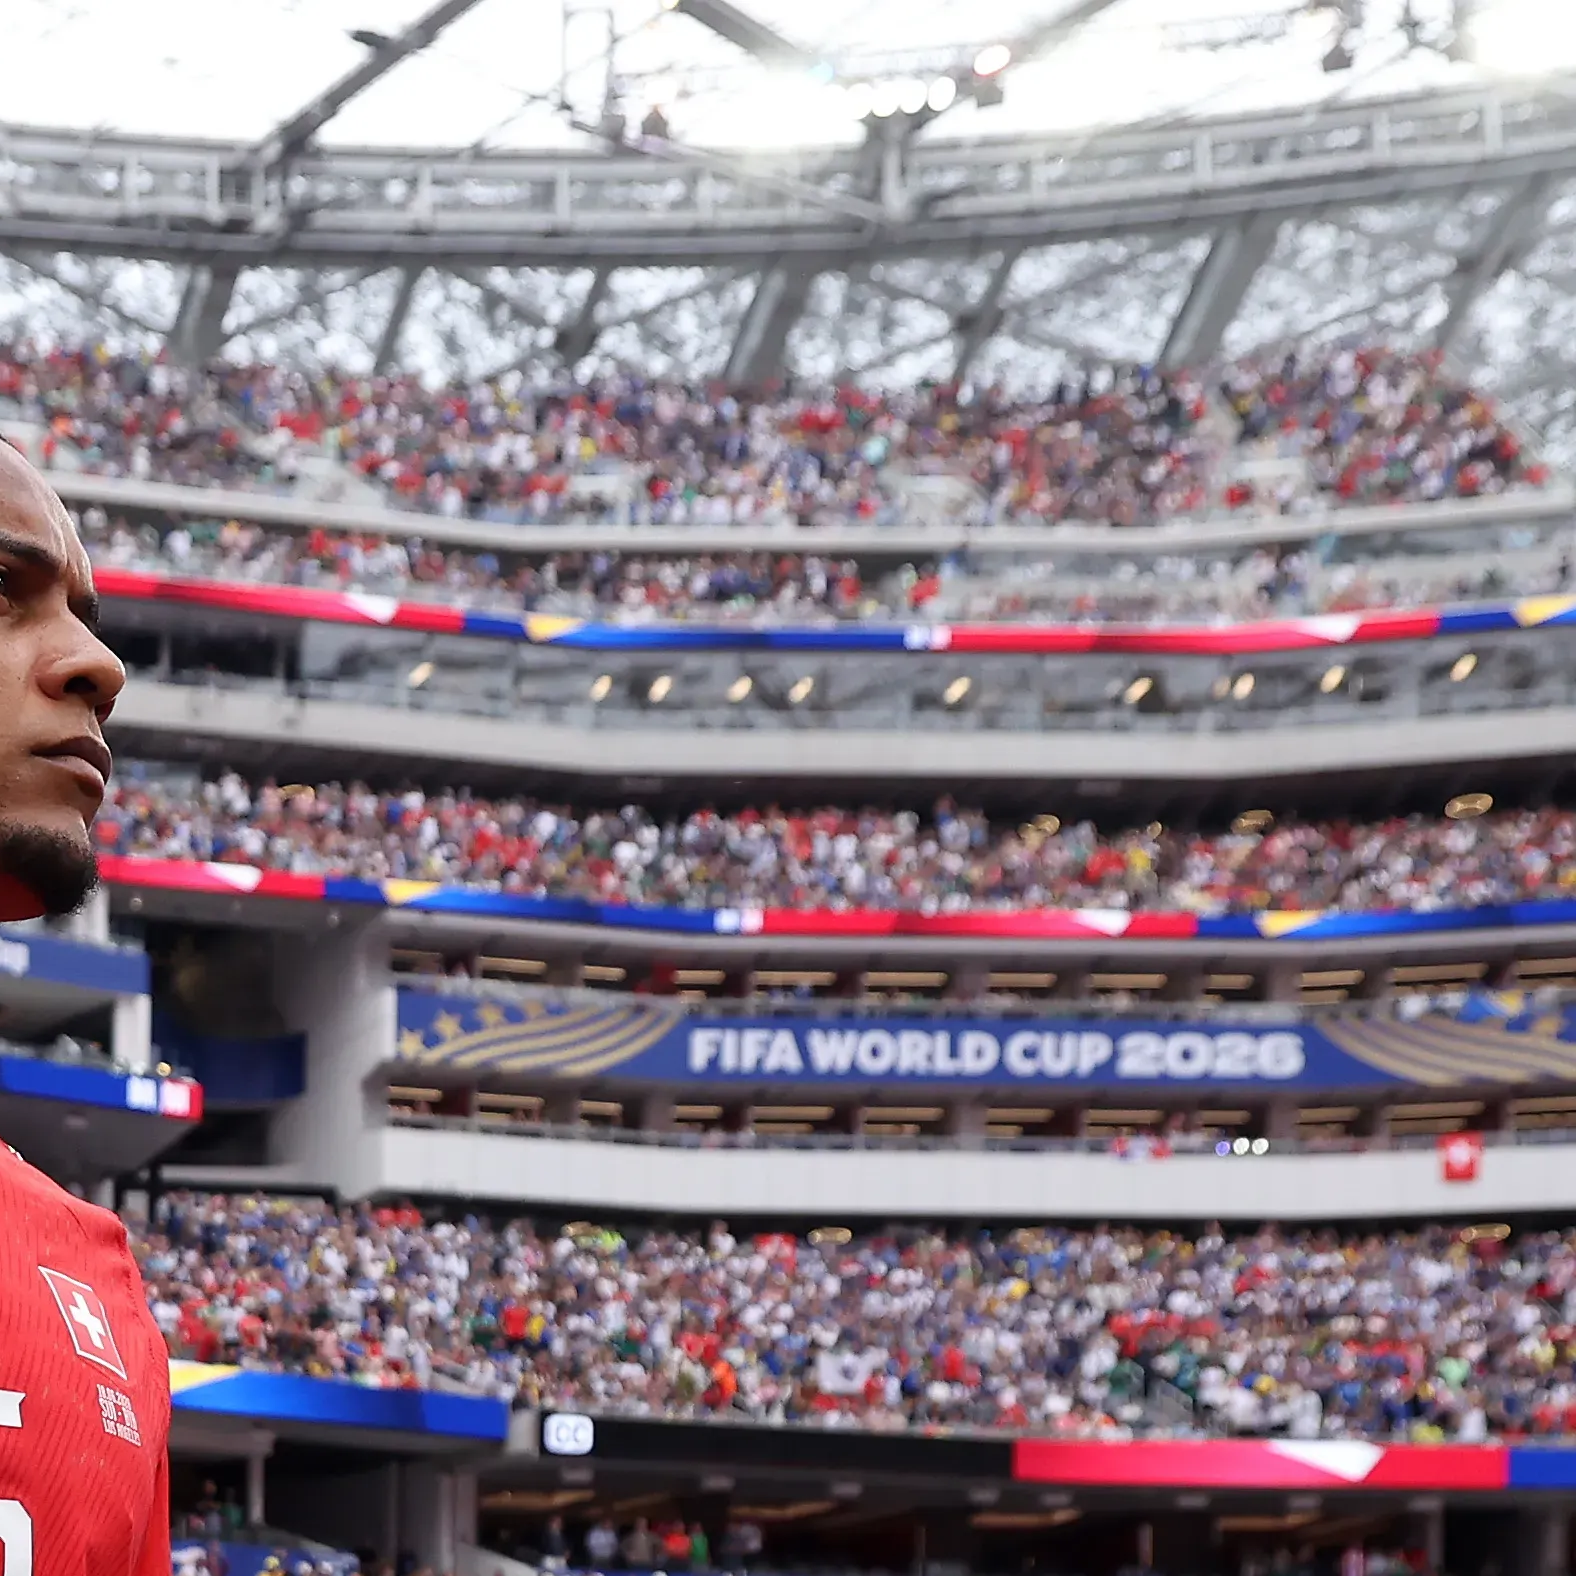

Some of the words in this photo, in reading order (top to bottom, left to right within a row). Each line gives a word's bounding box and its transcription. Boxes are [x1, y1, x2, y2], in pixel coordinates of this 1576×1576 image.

[688, 1028, 804, 1074] FIFA
[808, 1029, 1000, 1076] WORLD
[1004, 1030, 1113, 1077] CUP
[1115, 1030, 1307, 1079] 2026
